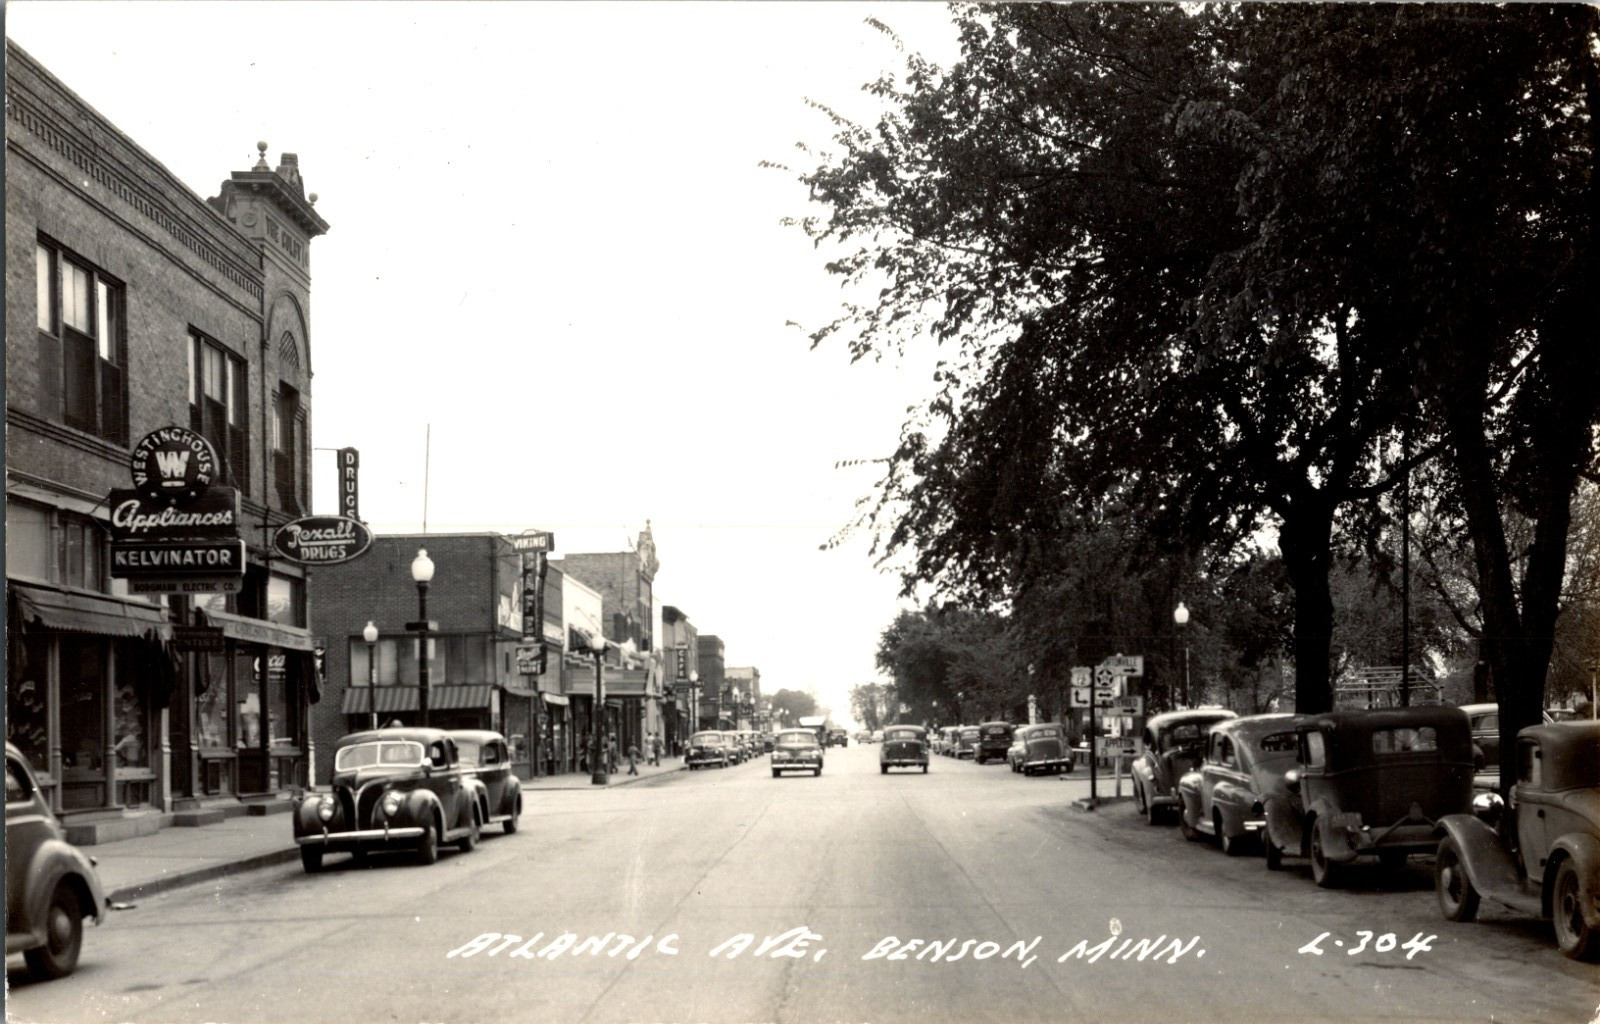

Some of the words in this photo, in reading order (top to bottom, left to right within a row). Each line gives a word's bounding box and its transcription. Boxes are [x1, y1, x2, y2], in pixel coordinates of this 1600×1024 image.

[134, 429, 210, 486] WESTINGHOUSE
[155, 451, 190, 479] W
[345, 452, 355, 519] DRUGS
[112, 500, 233, 534] Appliances
[286, 521, 356, 548] Rexall
[513, 535, 546, 549] VIKING
[115, 549, 232, 566] KELVINATOR
[300, 545, 346, 560] DRUGS
[182, 582, 217, 592] ELECTRIC
[523, 552, 536, 634] CAFE
